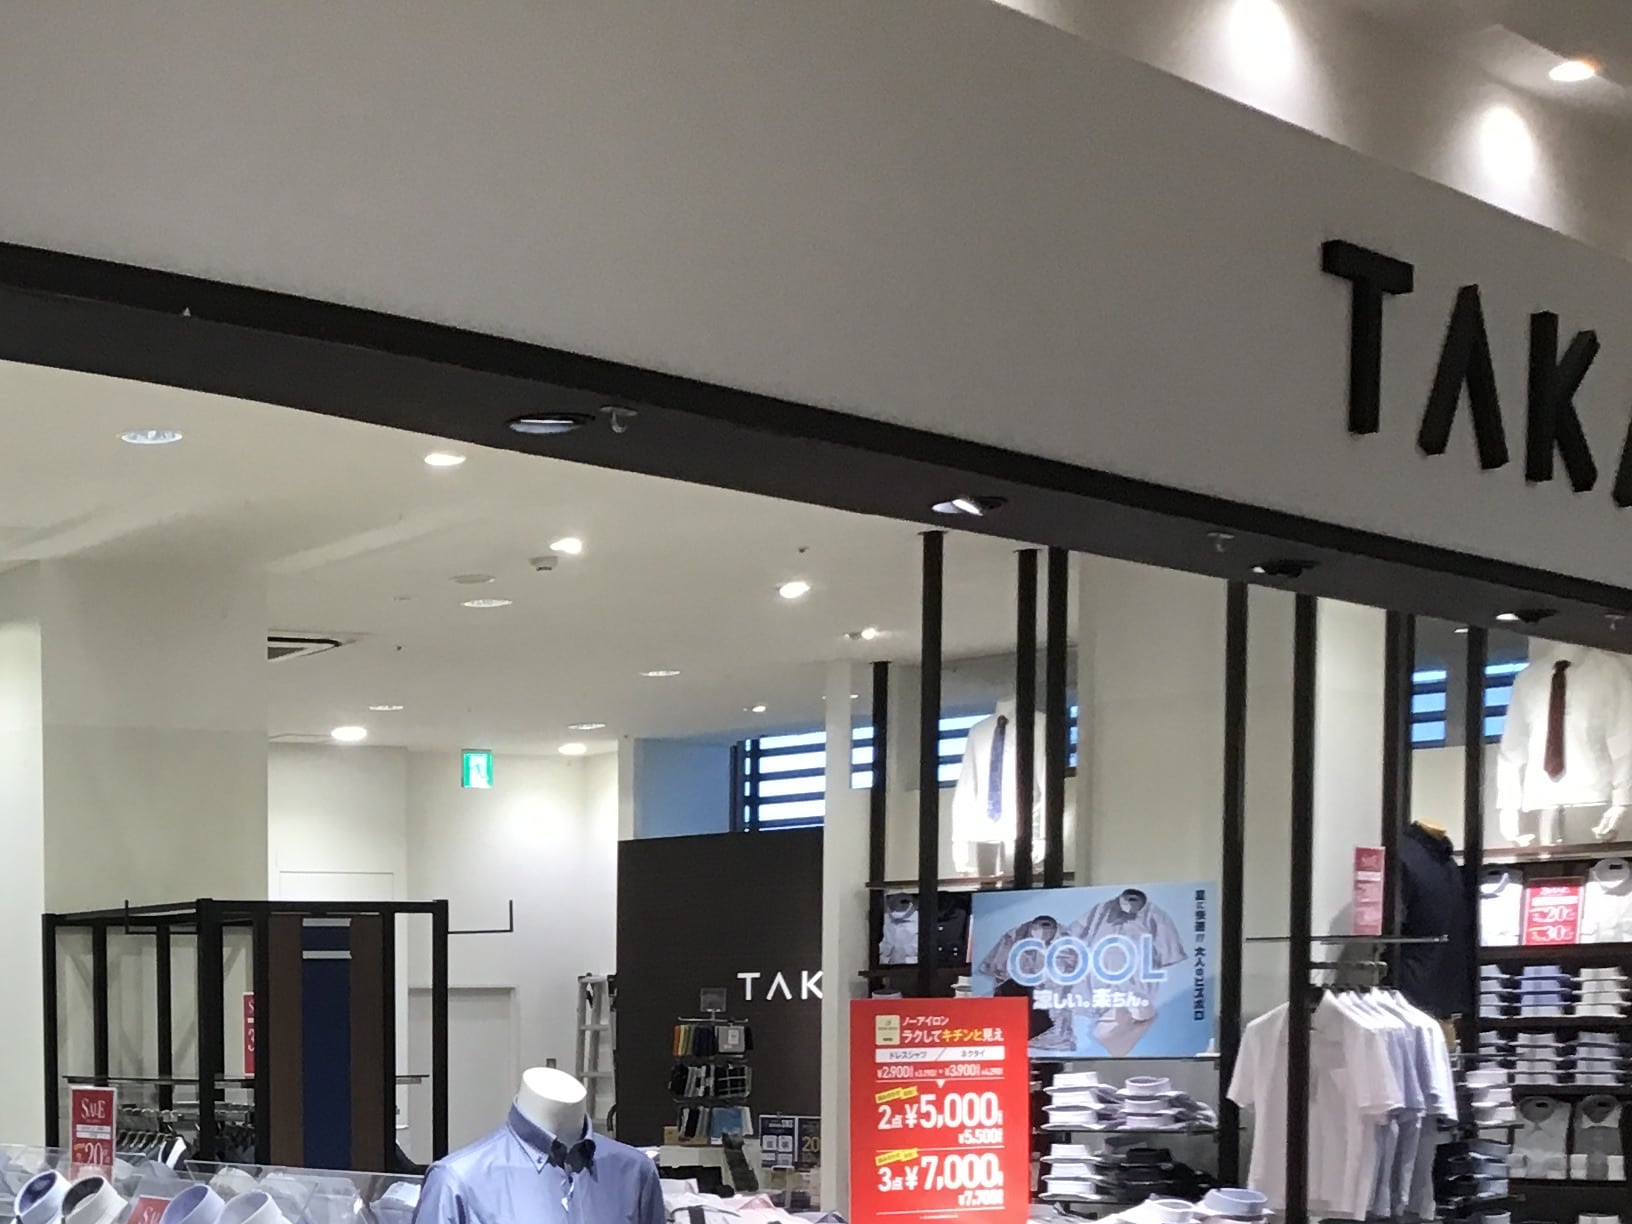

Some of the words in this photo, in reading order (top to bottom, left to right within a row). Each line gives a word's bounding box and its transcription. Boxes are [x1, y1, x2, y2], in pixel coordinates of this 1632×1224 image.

[1321, 240, 1632, 507] TAK
[1007, 934, 1168, 987] COOL
[737, 970, 824, 1001] TAK
[902, 1016, 950, 1026] ノーアイロン
[902, 1028, 1004, 1043] ラクしてキチンと見え
